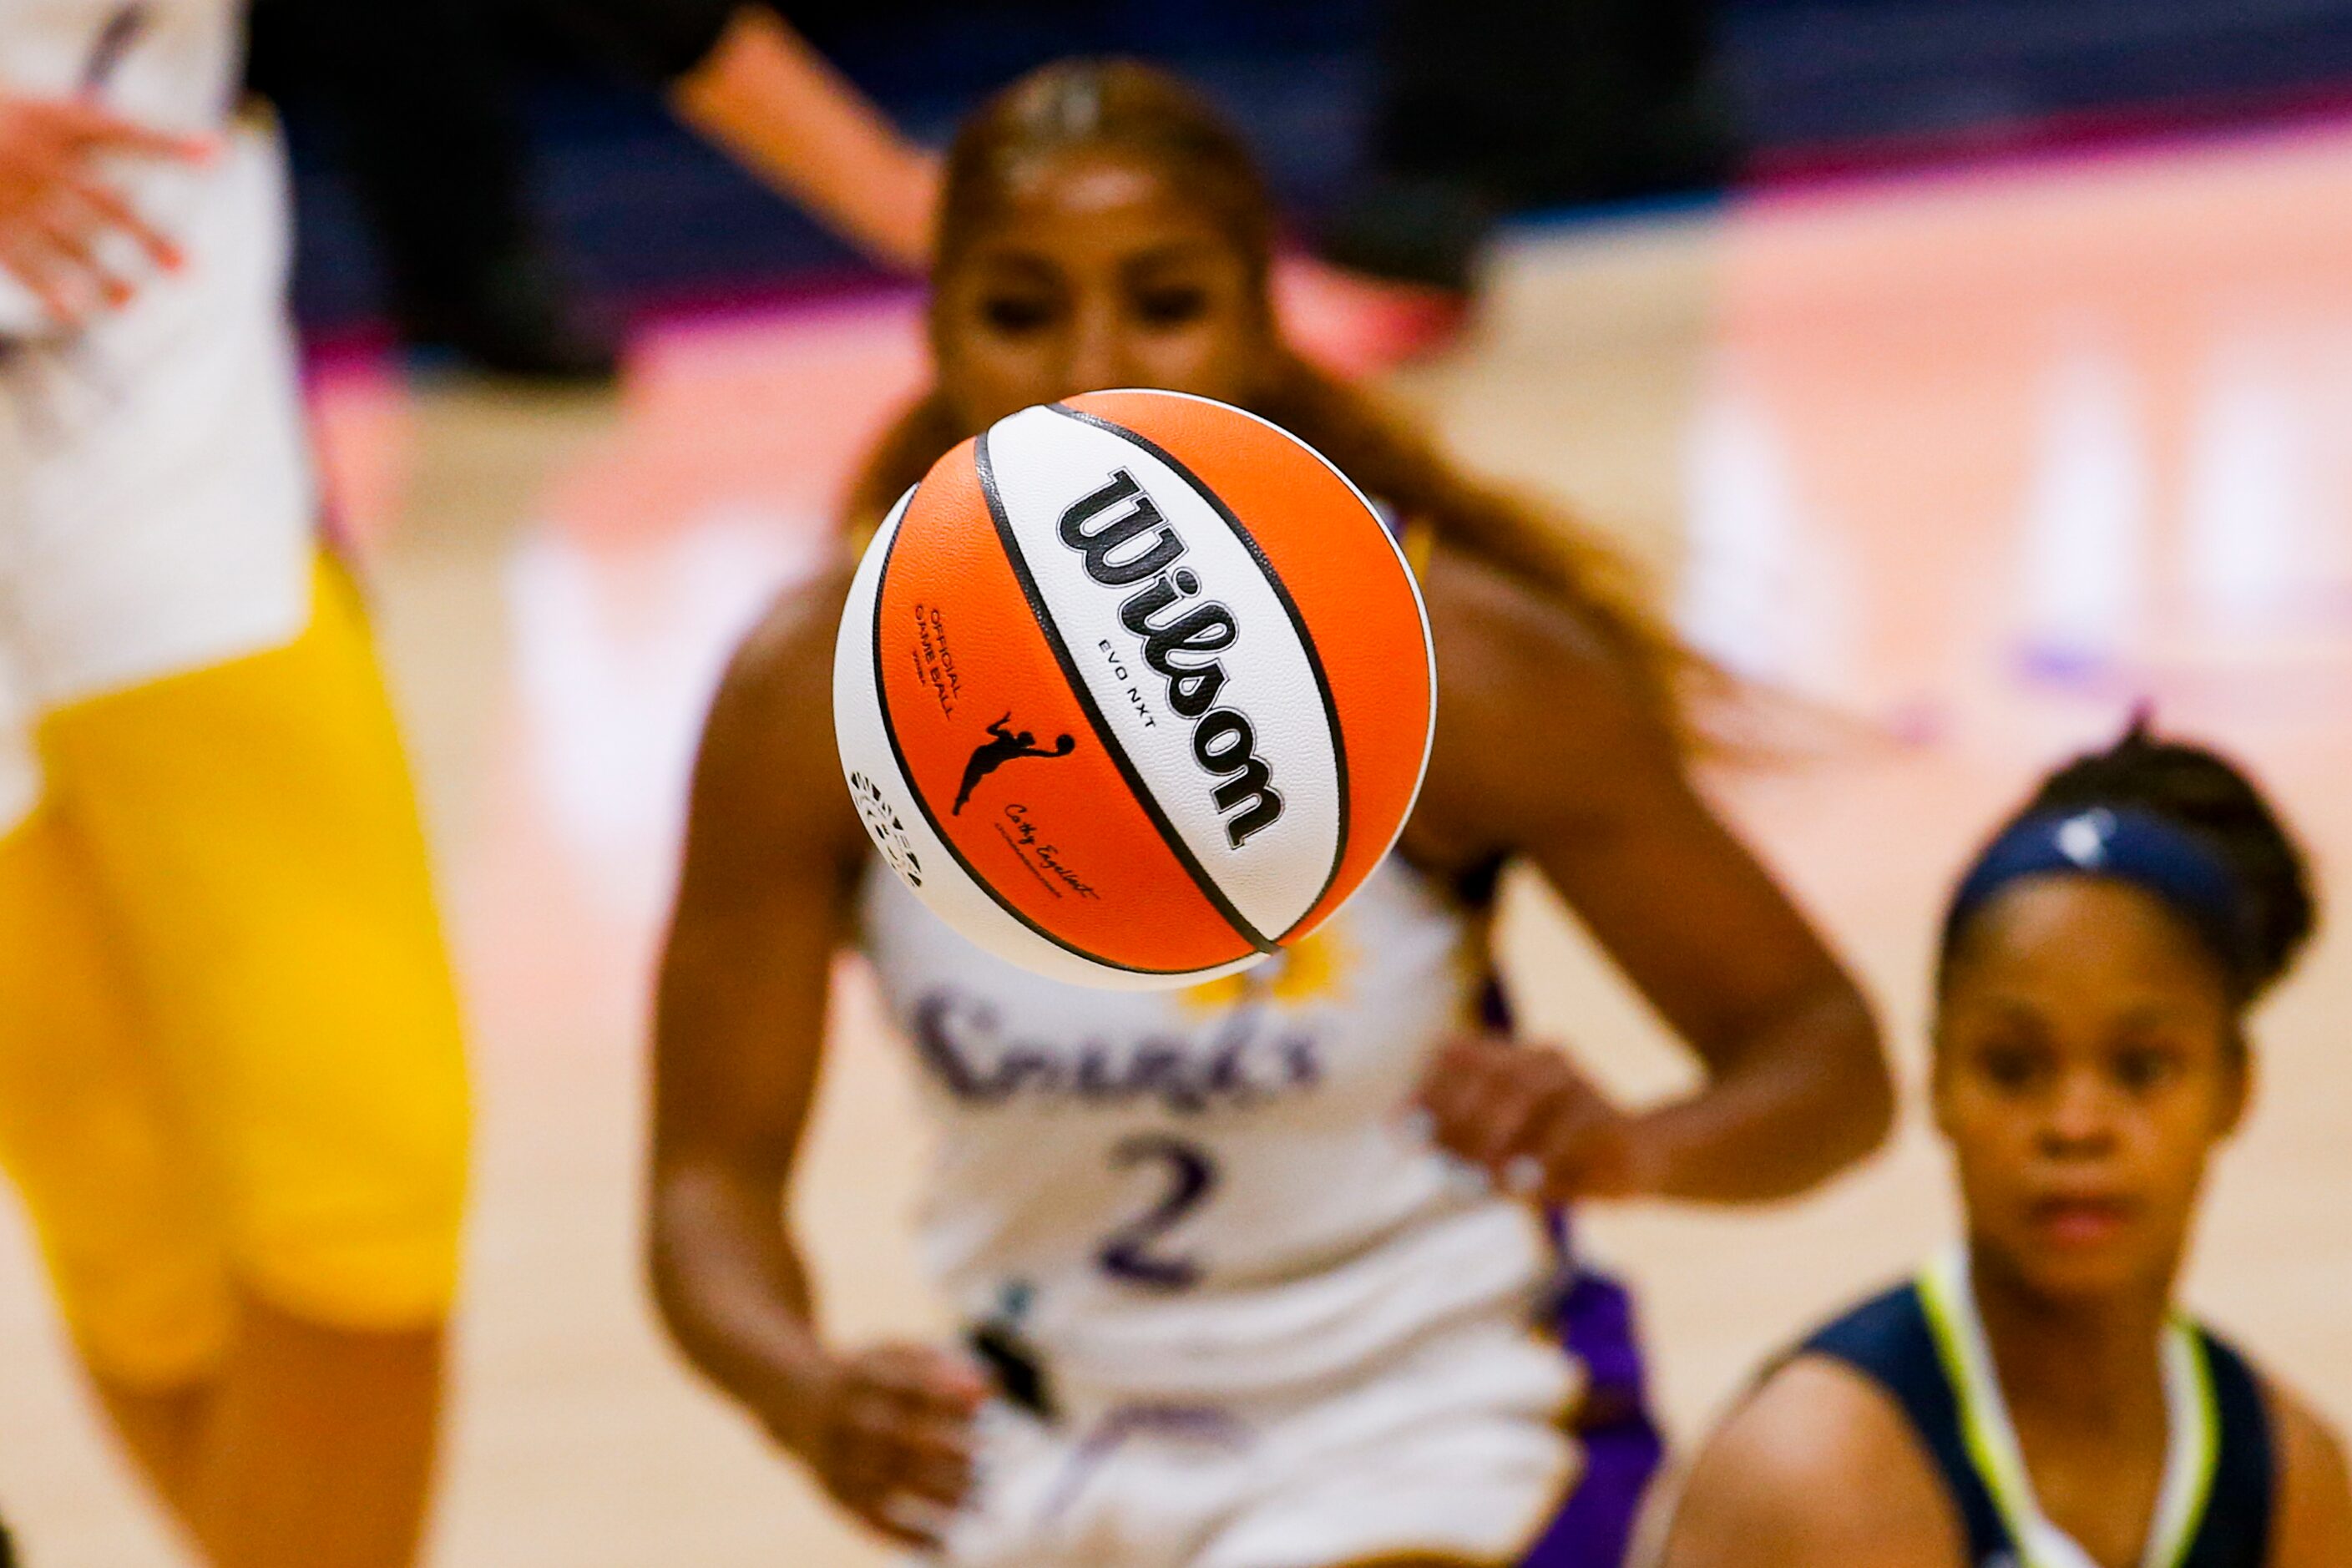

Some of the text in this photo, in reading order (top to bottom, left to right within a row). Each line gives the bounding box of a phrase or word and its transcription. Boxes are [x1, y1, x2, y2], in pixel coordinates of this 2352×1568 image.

[915, 604, 953, 721] GAME BALL
[931, 609, 961, 700] OFFICIAL
[1055, 466, 1285, 850] Wilson
[1099, 640, 1156, 727] EVO NXT
[1004, 804, 1037, 845] Cathy
[1097, 1136, 1219, 1291] 2
